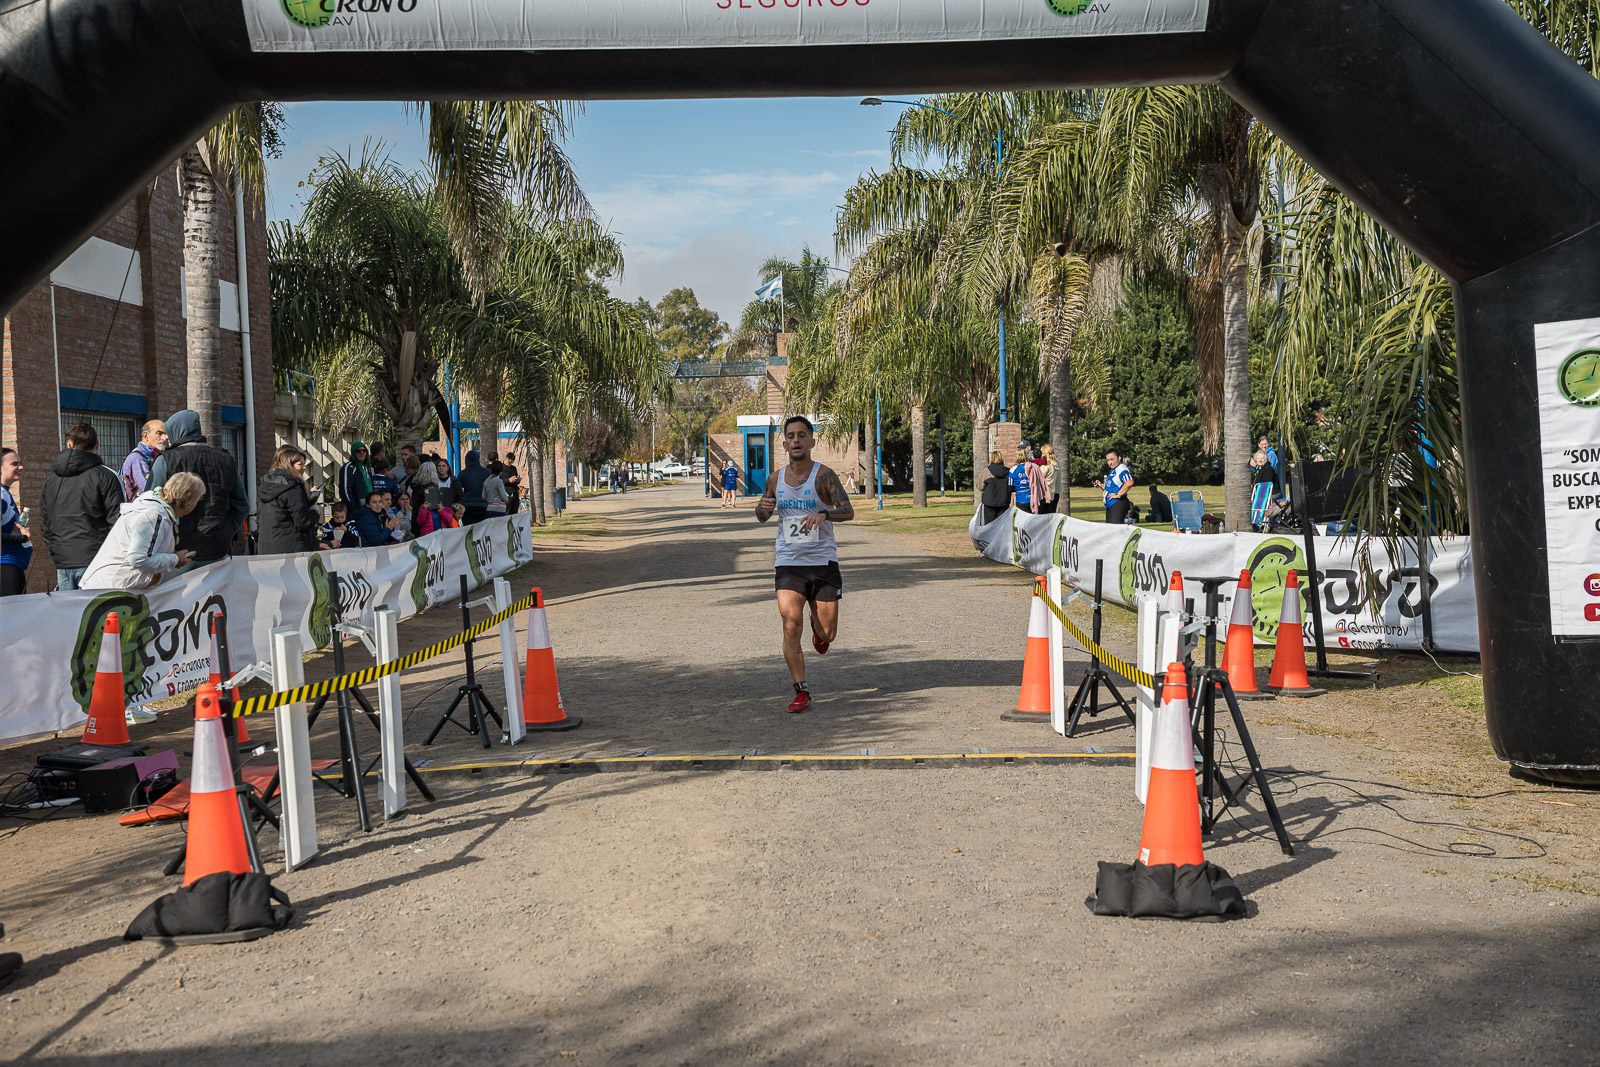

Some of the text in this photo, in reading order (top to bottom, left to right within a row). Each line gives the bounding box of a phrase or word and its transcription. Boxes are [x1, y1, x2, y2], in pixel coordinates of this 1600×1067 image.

[1077, 3, 1111, 15] RAV
[319, 16, 354, 27] RAV
[789, 523, 810, 538] 24
